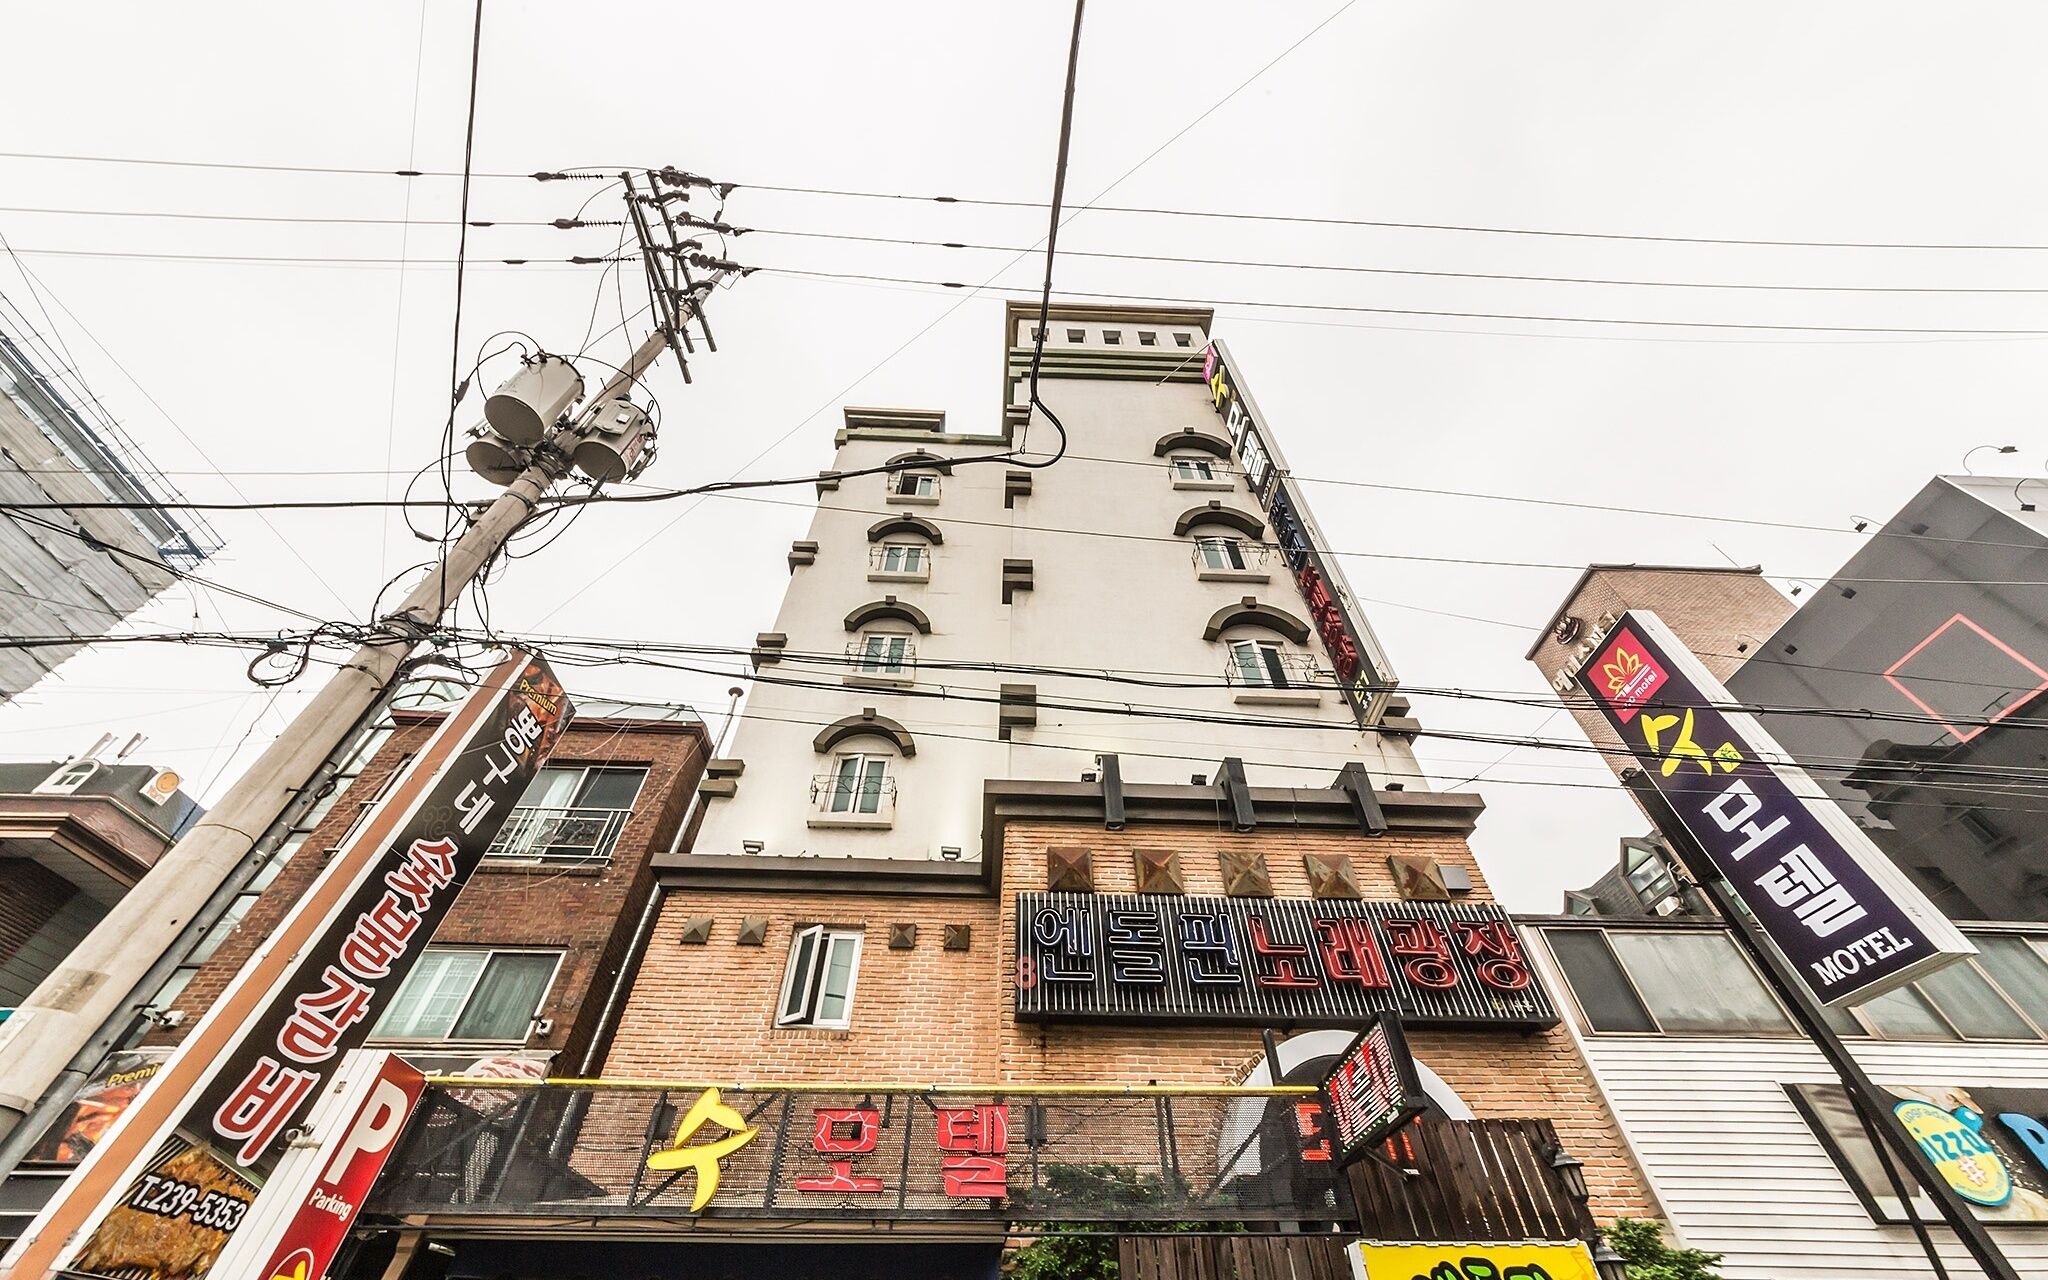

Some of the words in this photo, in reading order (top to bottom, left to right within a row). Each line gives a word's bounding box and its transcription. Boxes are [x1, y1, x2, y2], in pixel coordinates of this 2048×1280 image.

[1227, 401, 1269, 487] 모텔
[519, 678, 557, 716] Premium
[1635, 670, 1658, 697] motel
[453, 705, 544, 836] 뽕구네
[1702, 778, 1868, 938] 모텔
[1811, 926, 1914, 986] MOTEL
[212, 837, 458, 1167] 숯불갈비
[324, 1077, 408, 1186] P
[795, 1104, 1010, 1199] 모텔
[131, 1175, 249, 1231] T.239-5353
[308, 1187, 354, 1222] Parking
